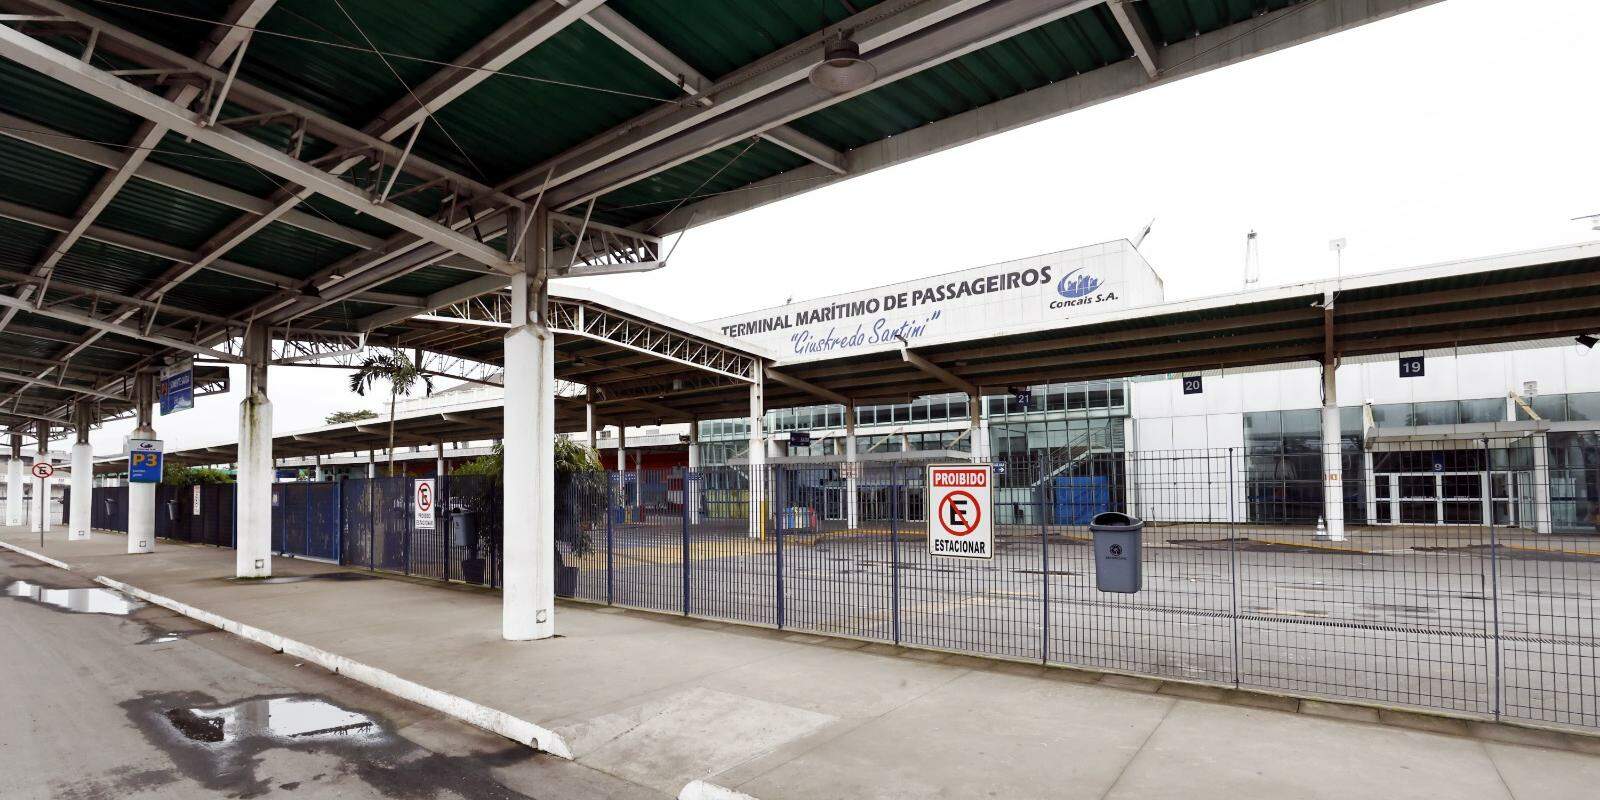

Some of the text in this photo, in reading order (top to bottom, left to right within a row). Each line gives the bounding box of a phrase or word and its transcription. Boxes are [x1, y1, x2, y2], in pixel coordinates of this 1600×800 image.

[721, 315, 793, 338] TERMINAL
[883, 293, 908, 312] DE
[912, 266, 1052, 307] PASSAGEIROS
[1050, 292, 1119, 309] Concais S.A.
[1403, 361, 1421, 373] 19
[1185, 380, 1201, 391] 20
[1018, 394, 1029, 403] 21
[133, 453, 158, 467] P3
[934, 472, 985, 485] PROIBIDO
[935, 539, 985, 553] ESTACIONAR
